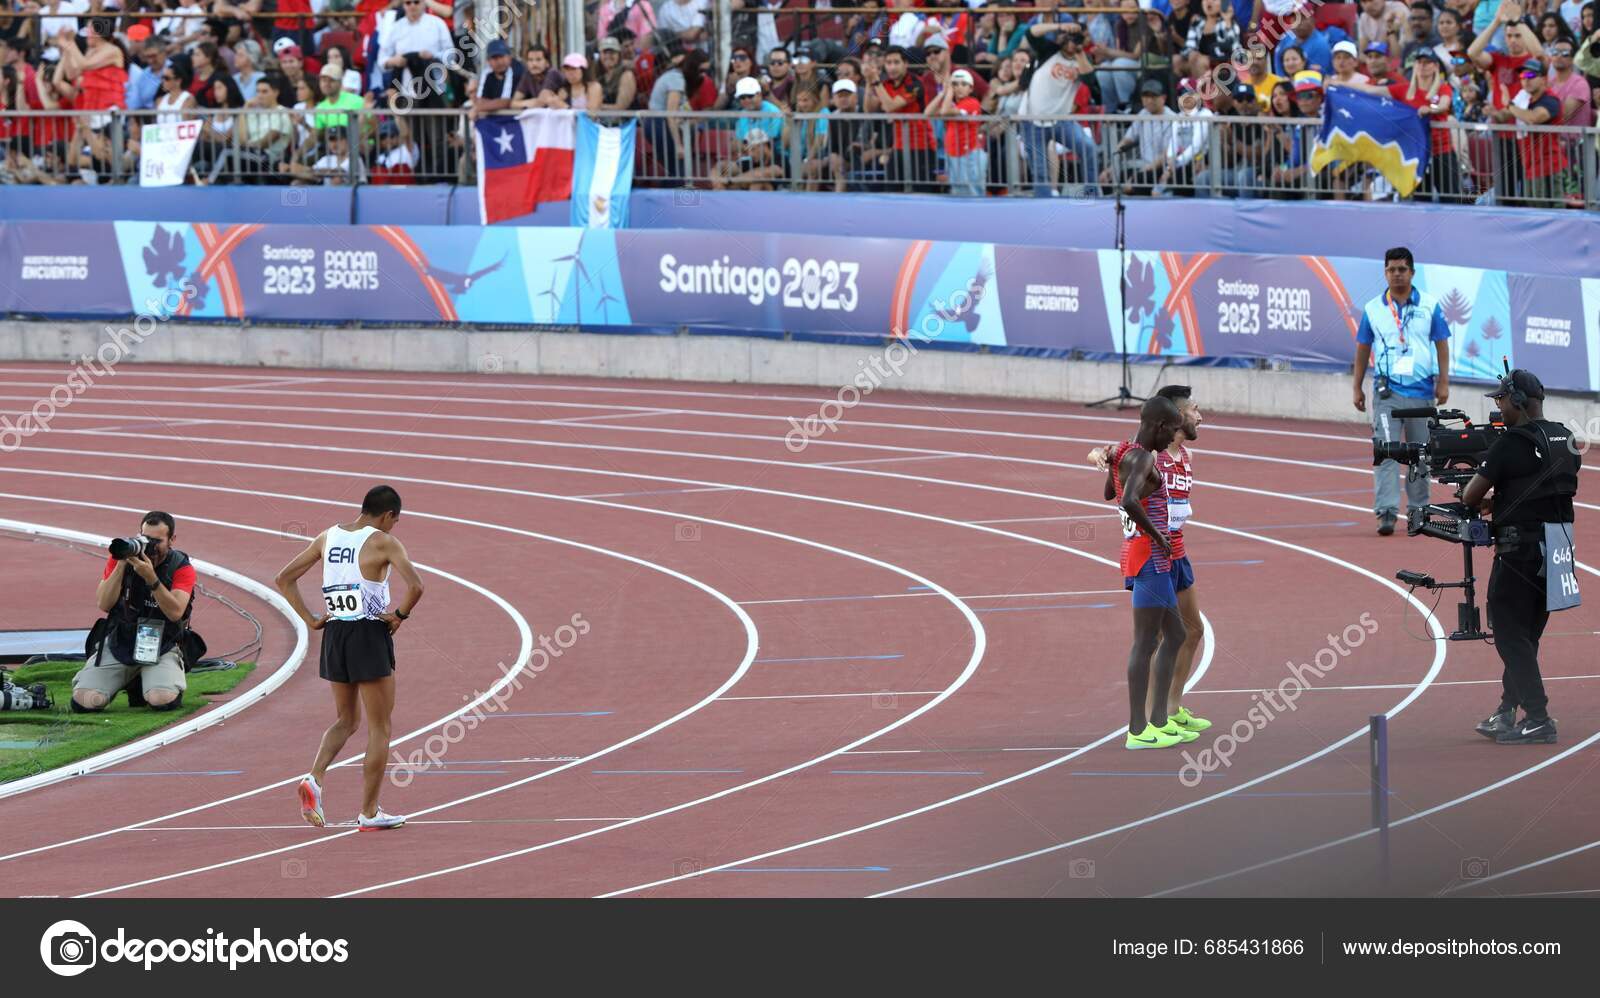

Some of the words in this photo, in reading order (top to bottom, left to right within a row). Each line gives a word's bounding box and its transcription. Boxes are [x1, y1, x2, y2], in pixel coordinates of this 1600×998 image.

[262, 244, 315, 264] Santiago
[324, 251, 378, 271] PANAM
[21, 265, 88, 280] ENCUENTRO
[263, 265, 316, 294] 2023
[324, 270, 380, 290] SPORTS
[659, 253, 781, 305] Santiago
[782, 257, 859, 312] 2023
[1217, 278, 1260, 301] Santiago
[1267, 286, 1311, 310] PANAM
[1025, 295, 1079, 312] ENCUENTRO
[1218, 301, 1260, 335] 2023
[1267, 308, 1312, 332] SPORTS
[1525, 327, 1571, 347] ENCUENTRO
[328, 546, 356, 564] EAI
[324, 594, 357, 611] 340
